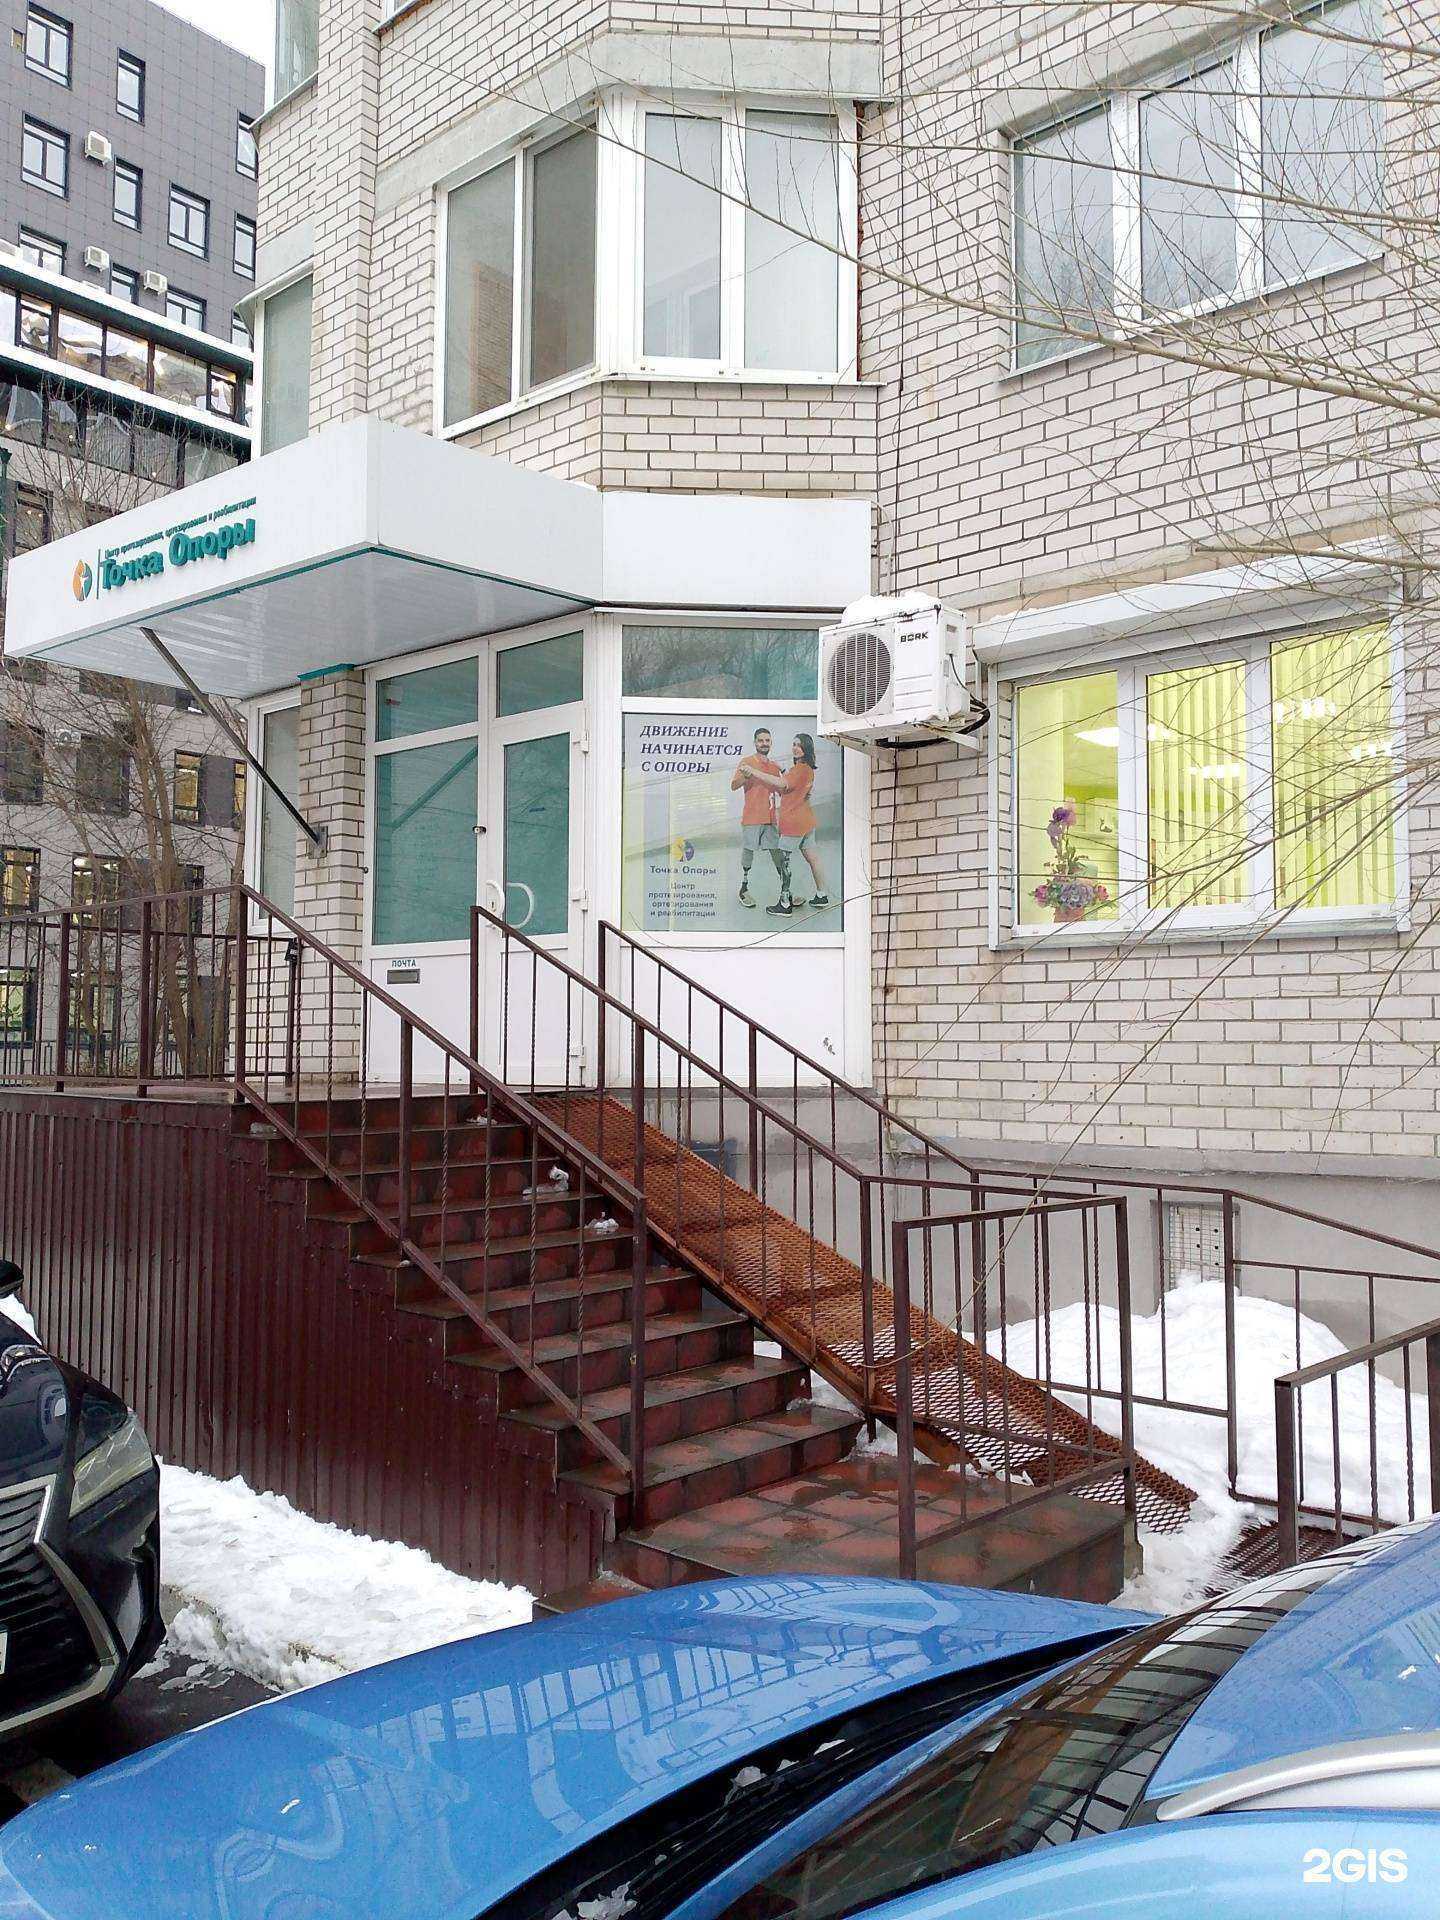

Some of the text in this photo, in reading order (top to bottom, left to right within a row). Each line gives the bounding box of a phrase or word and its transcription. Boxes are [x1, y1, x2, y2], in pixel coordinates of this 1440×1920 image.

[100, 518, 256, 590] Точка Опоры
[900, 631, 929, 643] BORK
[640, 725, 729, 738] ДВИЖЕНИЕ
[641, 743, 743, 756] НАЧИНАЕТСЯ
[641, 761, 711, 773] С ОПОРЫ
[650, 865, 717, 876] Точка Опоры
[671, 882, 695, 890] Центр
[648, 892, 717, 900] протеирования,
[391, 959, 417, 968] ПОЧТА
